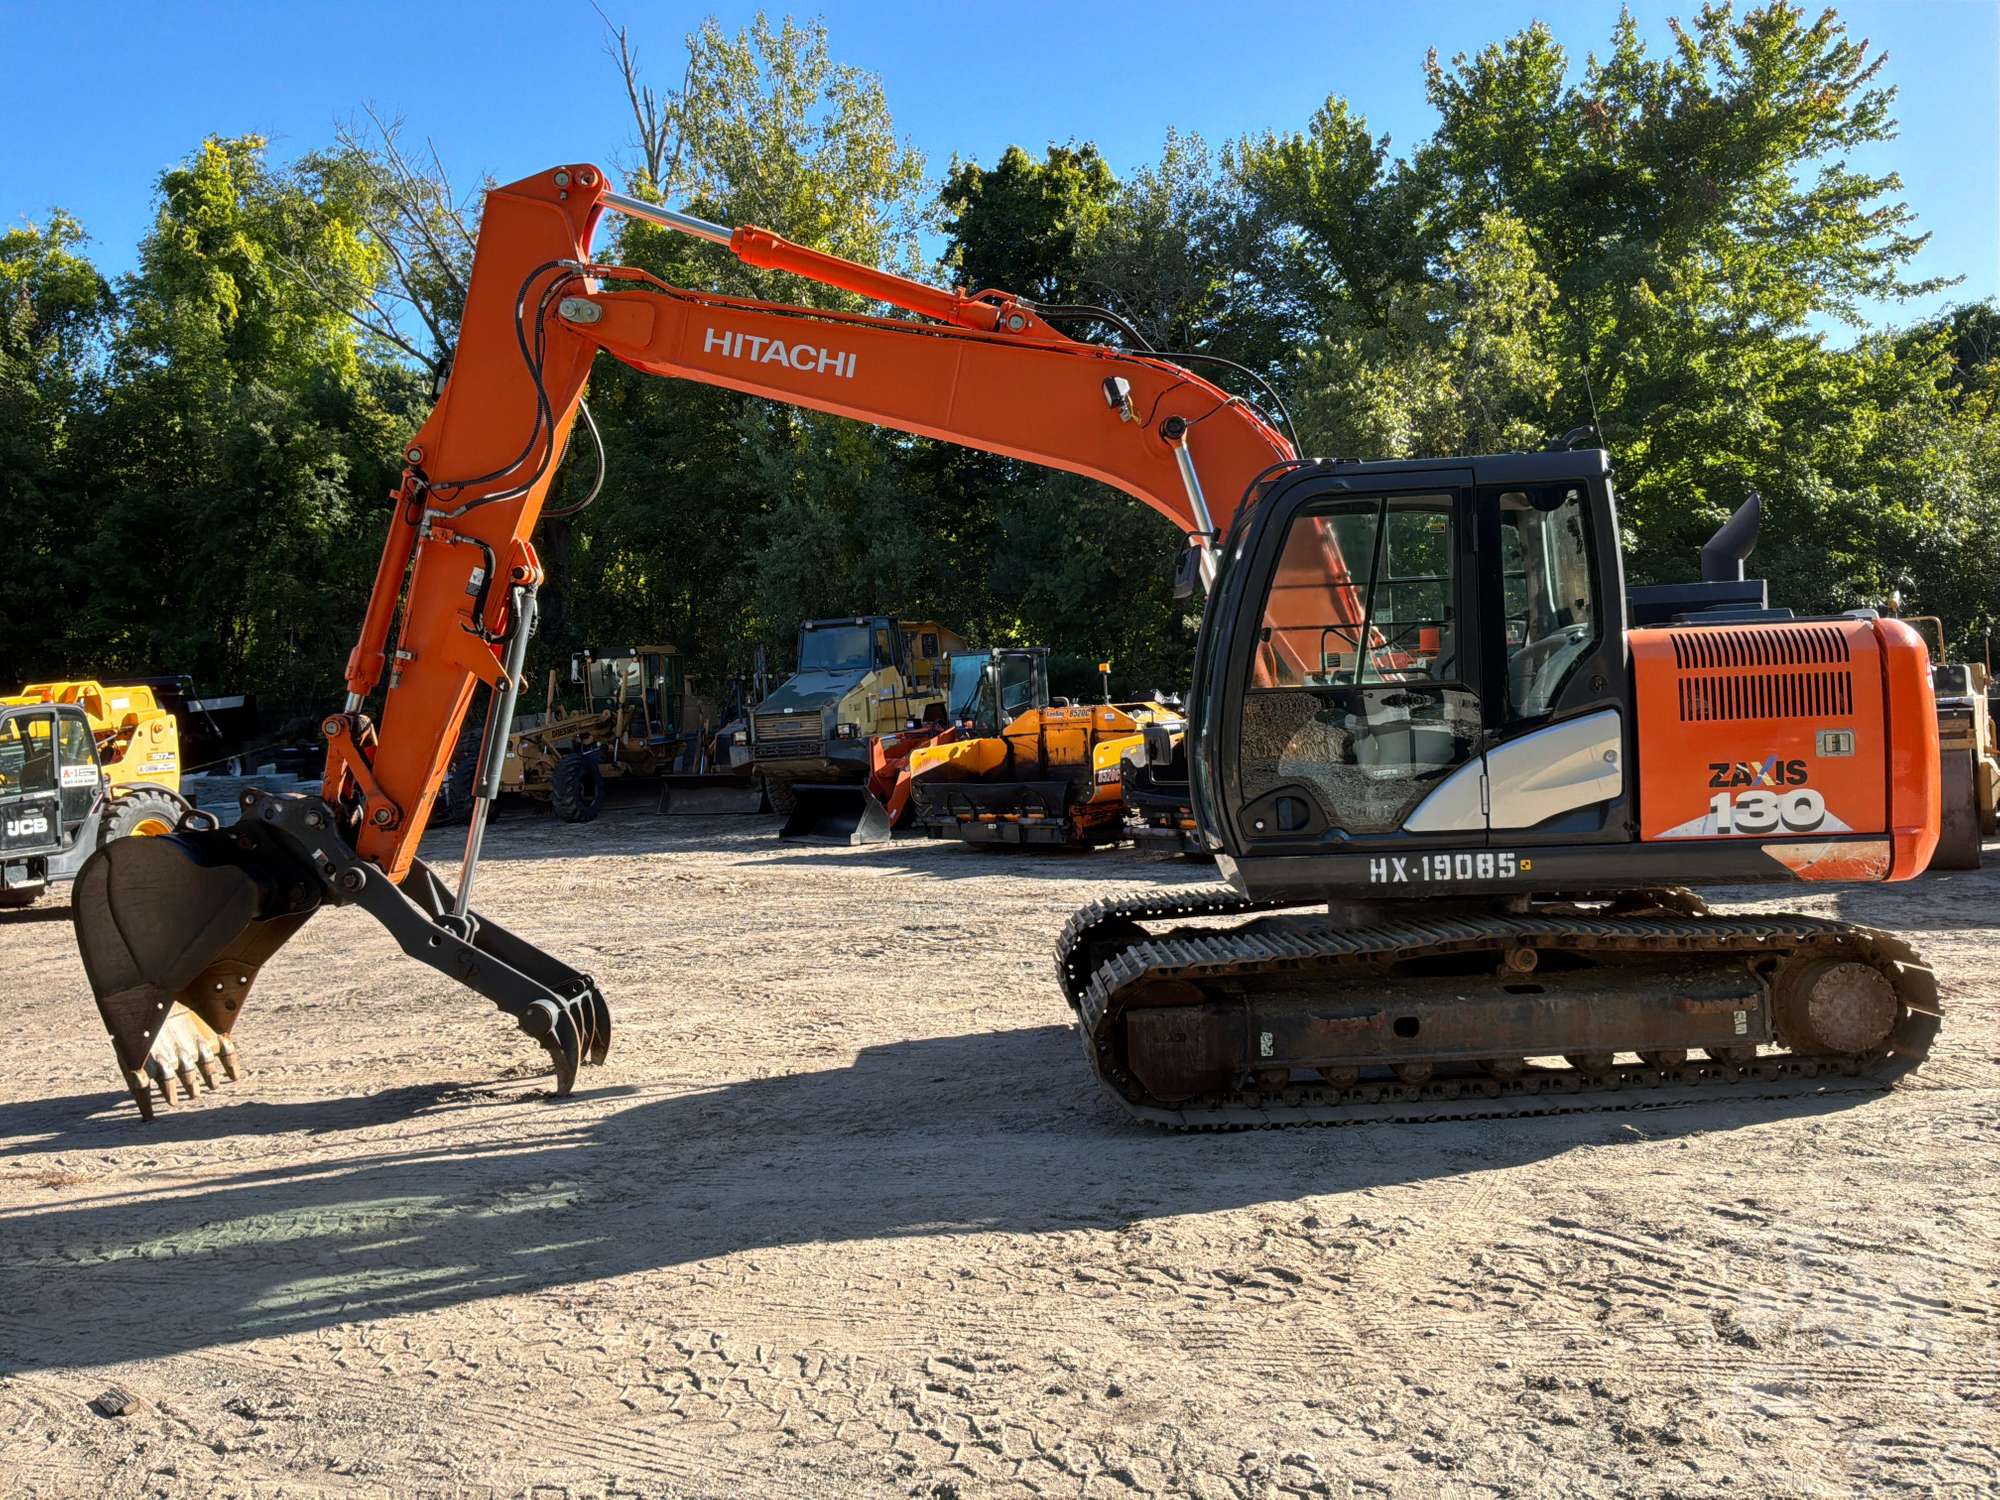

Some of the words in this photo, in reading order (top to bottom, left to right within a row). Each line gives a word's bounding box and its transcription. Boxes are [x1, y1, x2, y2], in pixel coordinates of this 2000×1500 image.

[704, 328, 857, 378] HITACHI
[1708, 754, 1808, 787] ZAXIS
[7, 818, 48, 836] JCB
[1710, 788, 1825, 834] 130
